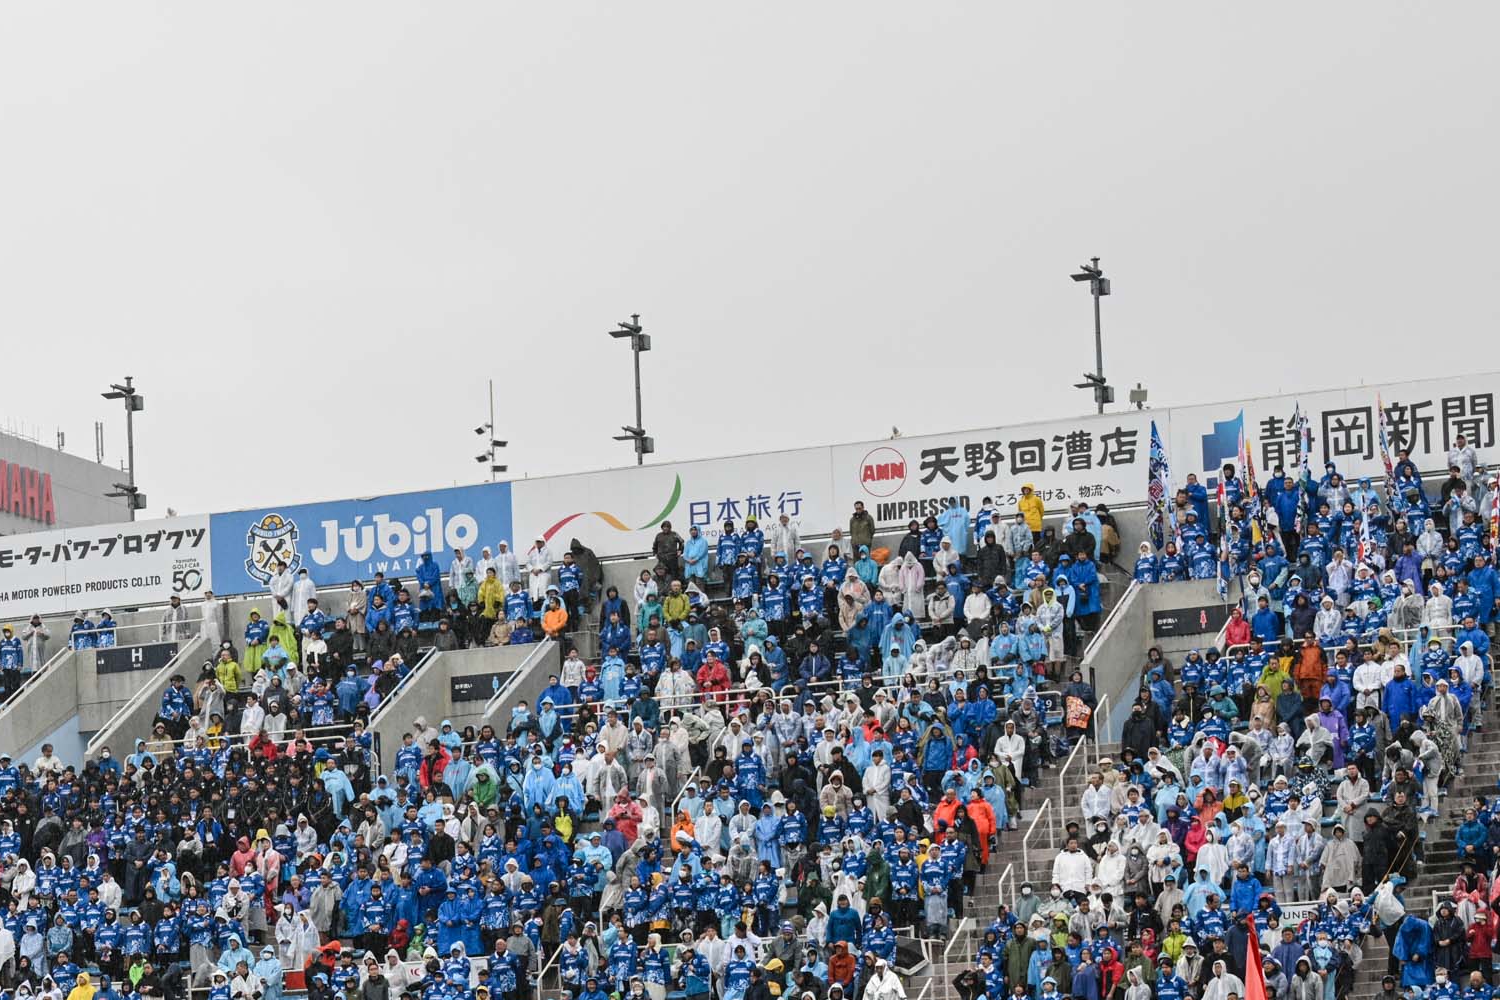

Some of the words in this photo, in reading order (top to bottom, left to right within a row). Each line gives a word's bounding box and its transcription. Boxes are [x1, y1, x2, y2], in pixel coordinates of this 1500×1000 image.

[1260, 392, 1496, 472] 静岡新聞
[919, 426, 1138, 485] 天野回漕店
[689, 491, 803, 526] 日本旅行
[876, 495, 970, 522] IMPRESSD
[311, 507, 479, 566] Júbilo
[11, 588, 40, 600] MOTOR
[42, 584, 82, 598] POWERED
[85, 578, 129, 593] PRODUCTS
[131, 647, 143, 663] H
